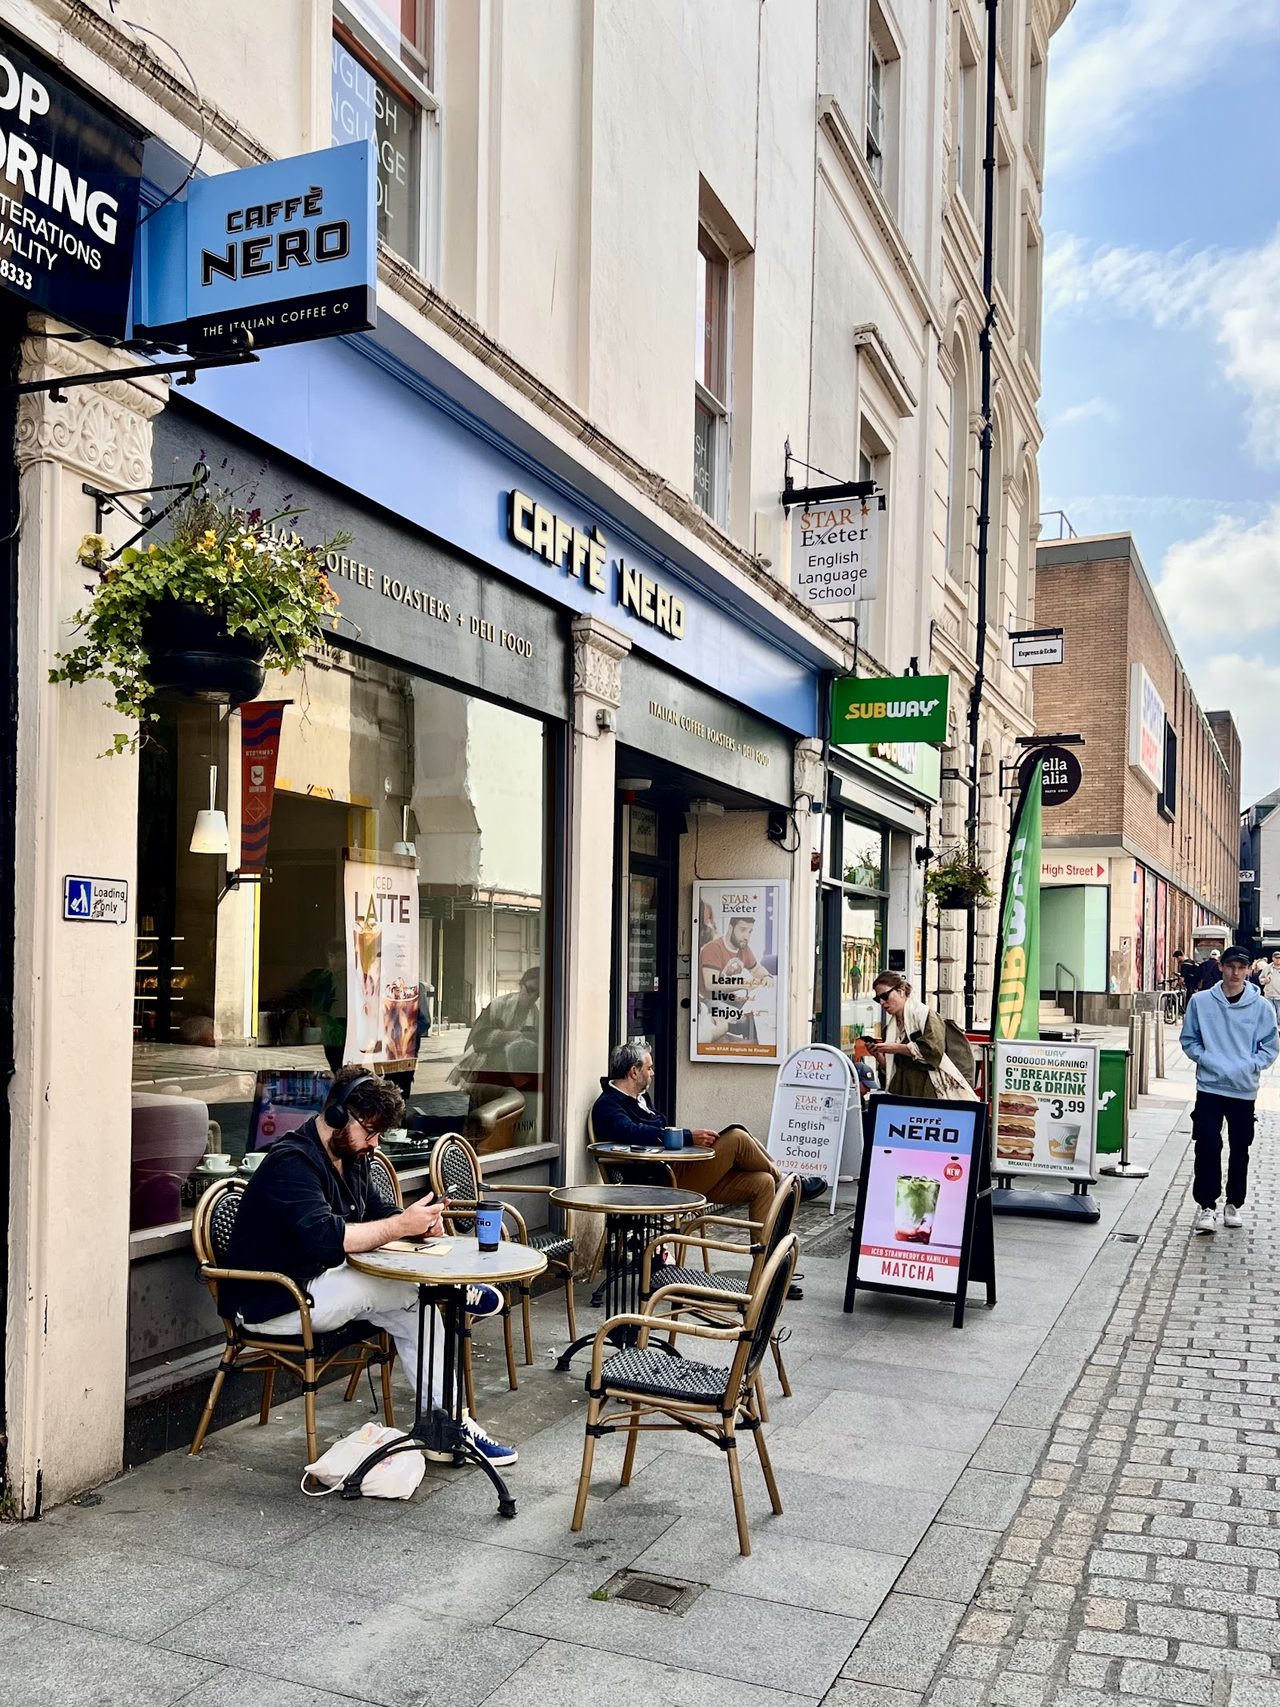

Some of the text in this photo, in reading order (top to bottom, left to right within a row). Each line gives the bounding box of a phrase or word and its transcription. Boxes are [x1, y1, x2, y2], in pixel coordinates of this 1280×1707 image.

[0, 128, 119, 245] RING
[226, 185, 323, 234] CAFFÈ
[201, 219, 350, 287] NERO
[203, 324, 223, 337] THE
[229, 315, 275, 332] ITALIAN
[281, 306, 327, 323] COFFEE
[801, 508, 854, 530] STAR
[800, 527, 869, 547] Exeter
[509, 488, 687, 641] CAFFÈ NERO
[808, 551, 859, 568] English
[798, 568, 868, 585] Language
[809, 583, 856, 600] School
[382, 575, 451, 623] ROASTERS
[471, 616, 496, 642] DELI
[501, 629, 533, 658] FOOD
[844, 698, 940, 720] SUBWAY
[649, 700, 678, 726] ITALIAN
[680, 715, 705, 738] COFFEE
[706, 727, 735, 752] ROASTERS
[741, 744, 754, 760] DELI
[755, 750, 770, 767] FOOD
[1042, 757, 1068, 771] ella
[1042, 771, 1069, 785] alia
[1041, 863, 1094, 878] High Street
[373, 875, 393, 890] ICED
[94, 886, 125, 901] Loading
[721, 894, 750, 904] STAR
[100, 902, 118, 914] only
[354, 891, 411, 924] LATTE
[722, 904, 757, 913] Exeter
[712, 974, 744, 985] Learn
[711, 990, 736, 1001] Live
[711, 1007, 743, 1020] Enjoy
[795, 1060, 824, 1071] STAR
[1006, 1055, 1088, 1069] GOOOOOD MORNING!
[795, 1069, 832, 1081] Exeter
[1005, 1067, 1087, 1083] 6" BREAKFAST
[1005, 1078, 1086, 1096] SUB & DRINK
[795, 1095, 817, 1104] STAR
[1050, 1099, 1085, 1119] 3.99
[788, 1119, 825, 1132] English
[909, 1116, 942, 1125] CAFFÈ
[780, 1132, 830, 1147] Language
[888, 1123, 960, 1144] NERO
[786, 1147, 821, 1159] School
[776, 1160, 828, 1172] 01392 666419
[946, 1167, 960, 1177] NEW
[181, 1179, 217, 1199] ESPR
[871, 1247, 883, 1255] ICED
[884, 1249, 919, 1260] STRAWBERRY
[926, 1256, 949, 1265] VANILLA
[881, 1261, 934, 1282] MATCHA
